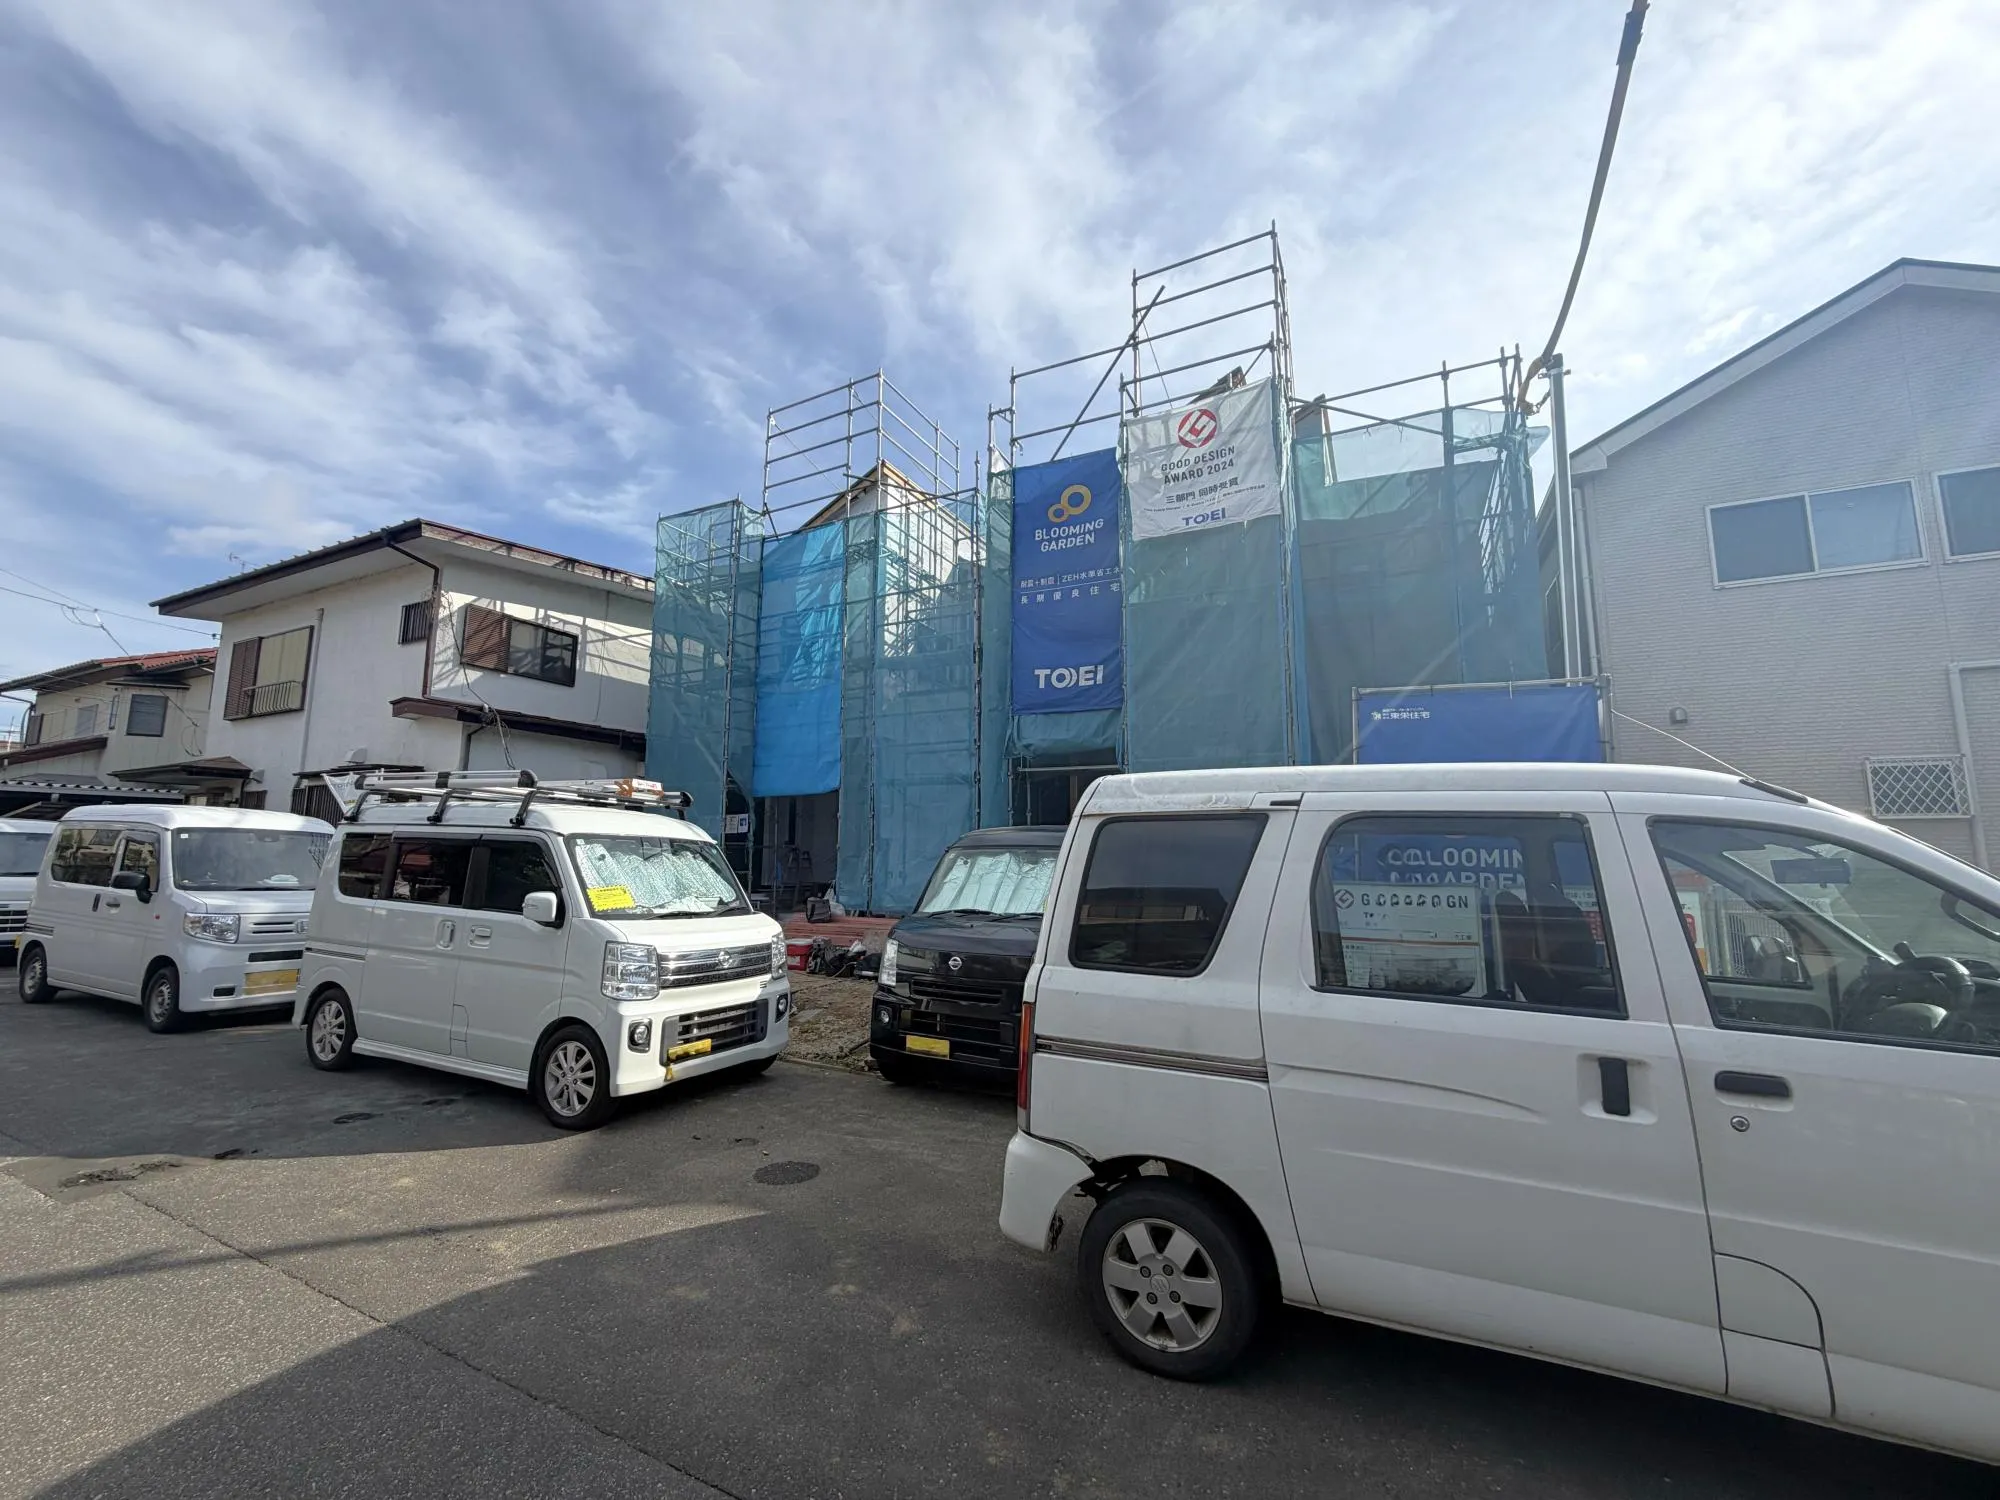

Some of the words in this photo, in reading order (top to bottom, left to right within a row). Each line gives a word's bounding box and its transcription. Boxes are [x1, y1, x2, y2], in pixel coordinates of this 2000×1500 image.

[1161, 459, 1191, 472] GOOD
[1194, 446, 1235, 465] DESIGN
[1164, 468, 1204, 485] AWARD
[1207, 458, 1234, 475] 2024
[1182, 507, 1227, 526] TOEI
[1035, 518, 1104, 541] BLOOMING
[1041, 533, 1095, 553] GARDEN
[1034, 664, 1104, 689] TOEI
